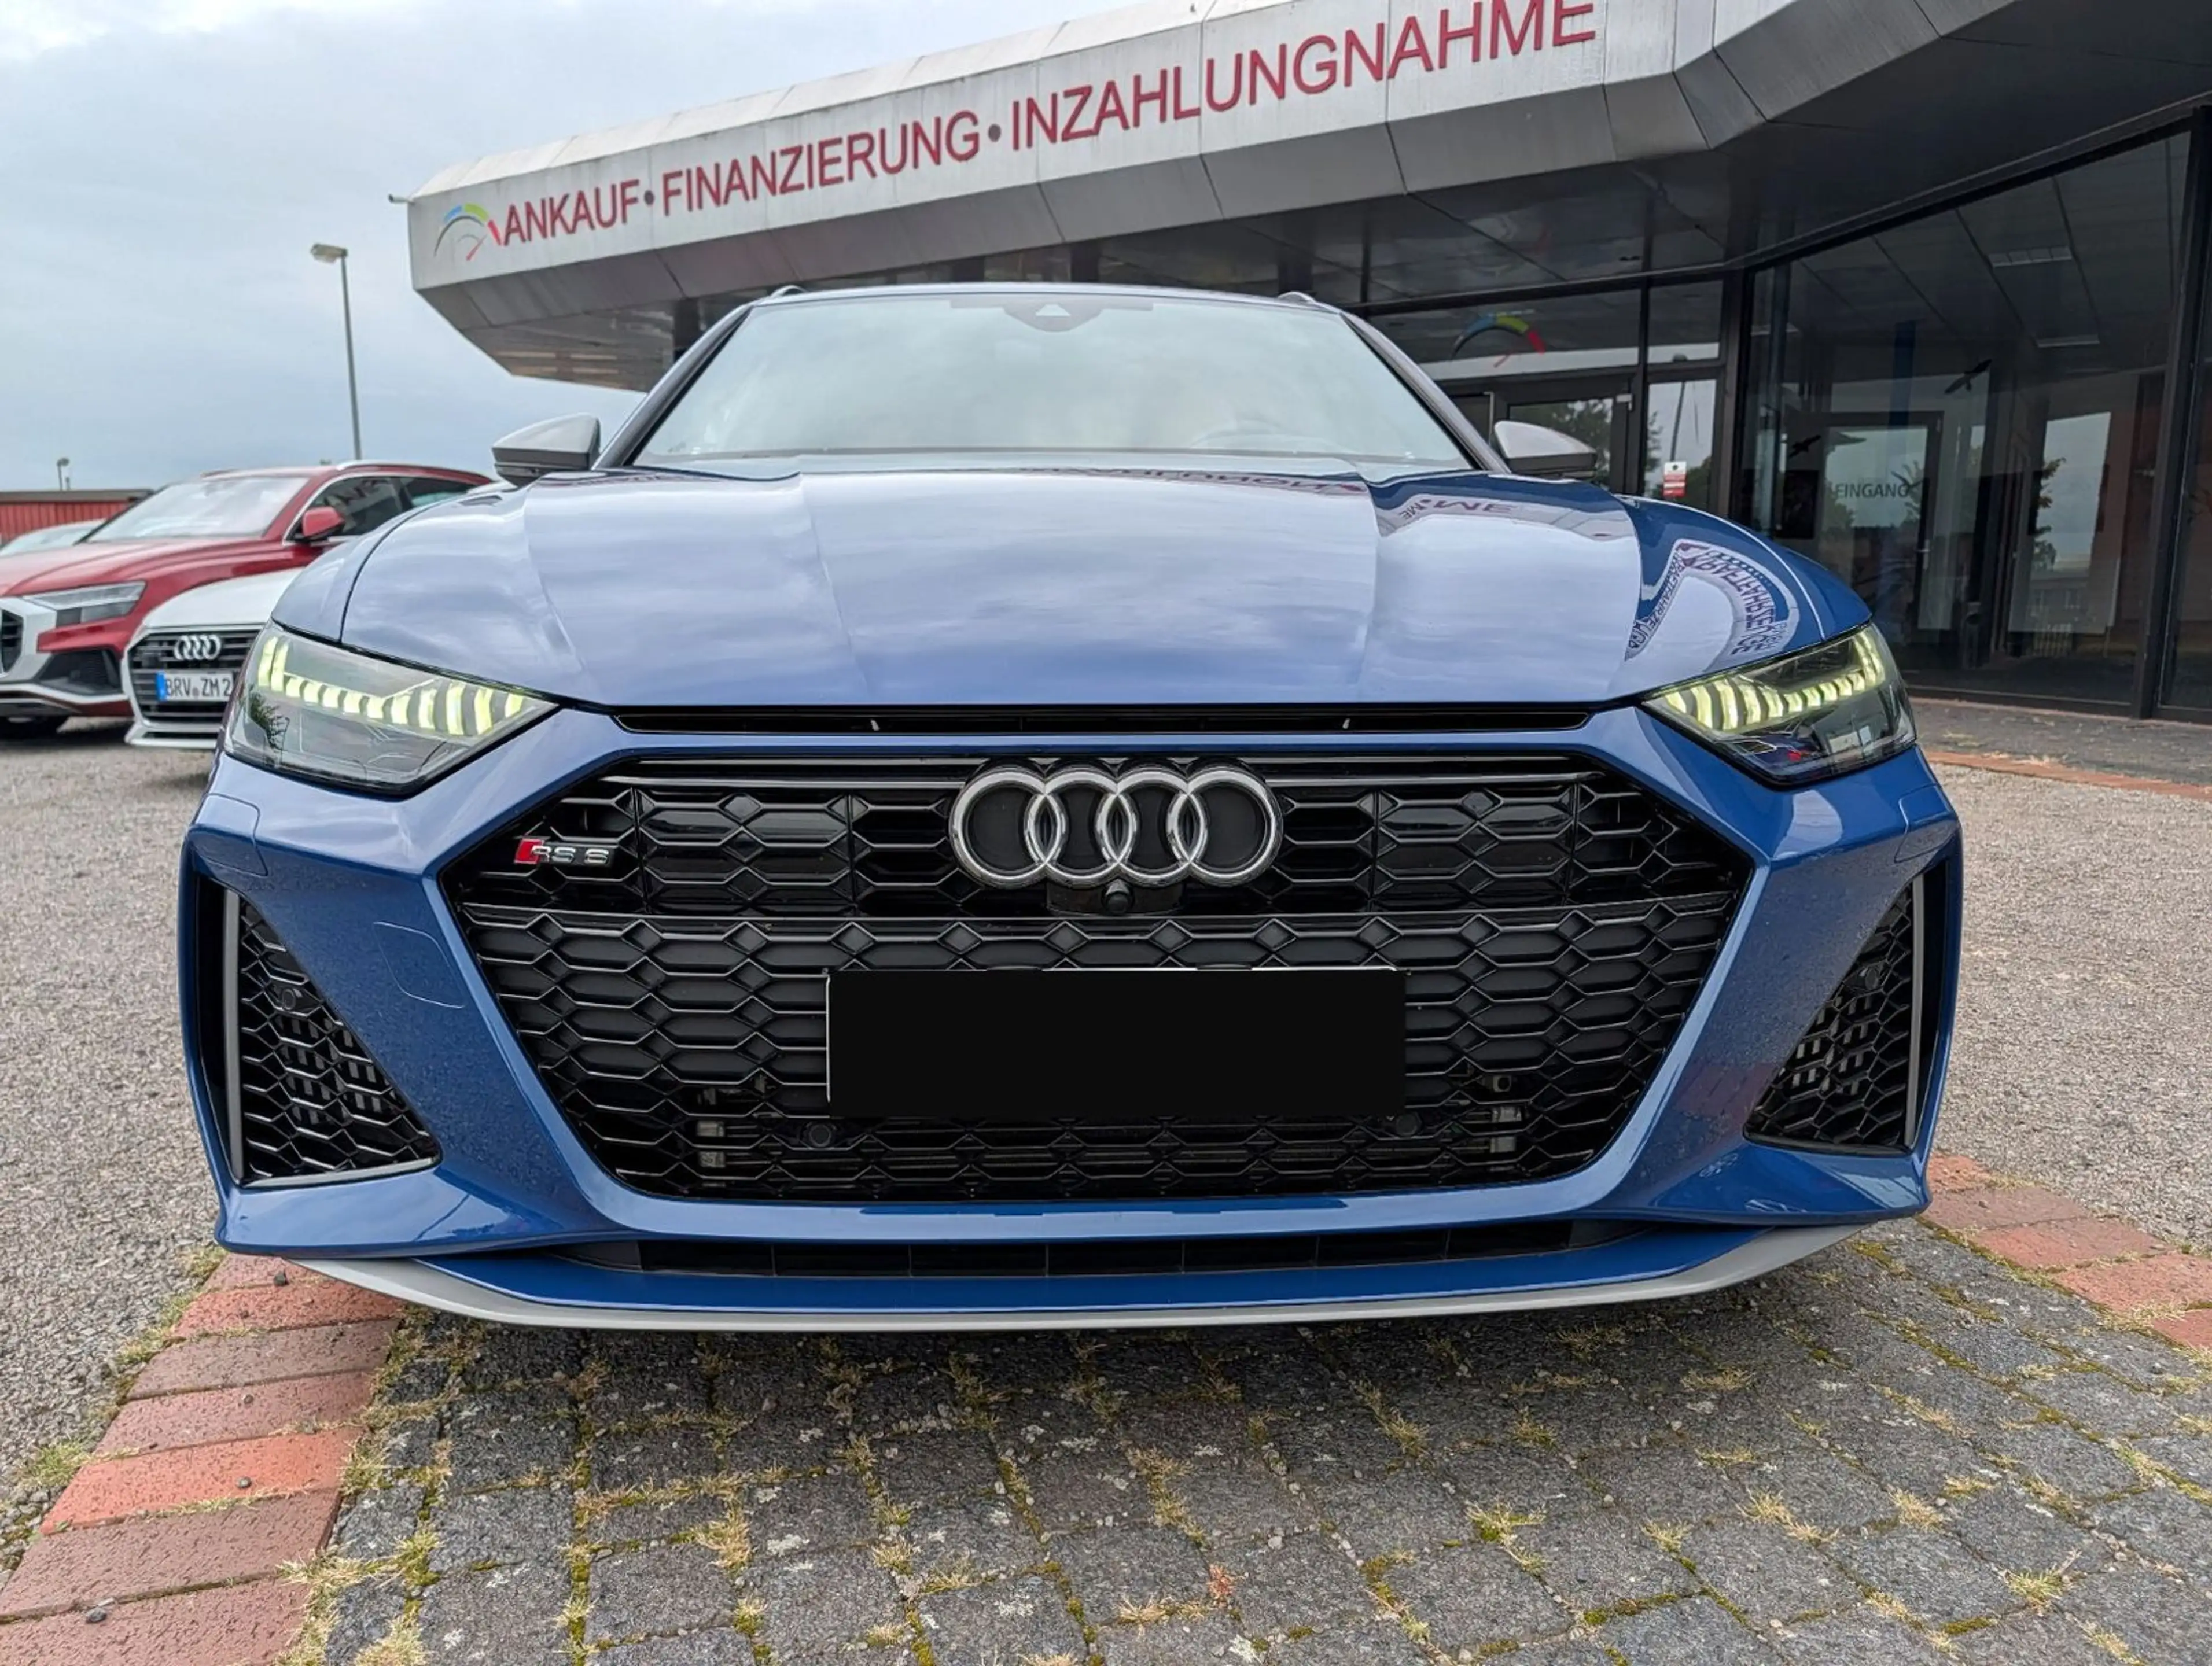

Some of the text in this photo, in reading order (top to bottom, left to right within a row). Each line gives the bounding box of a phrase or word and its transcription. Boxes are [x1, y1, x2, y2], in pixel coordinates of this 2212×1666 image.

[503, 0, 1596, 246] ANKAUF FINANZIERUNG INZAHLUNGNAHME
[167, 677, 192, 696] BRV
[200, 677, 220, 696] ZM
[531, 845, 576, 863] RS
